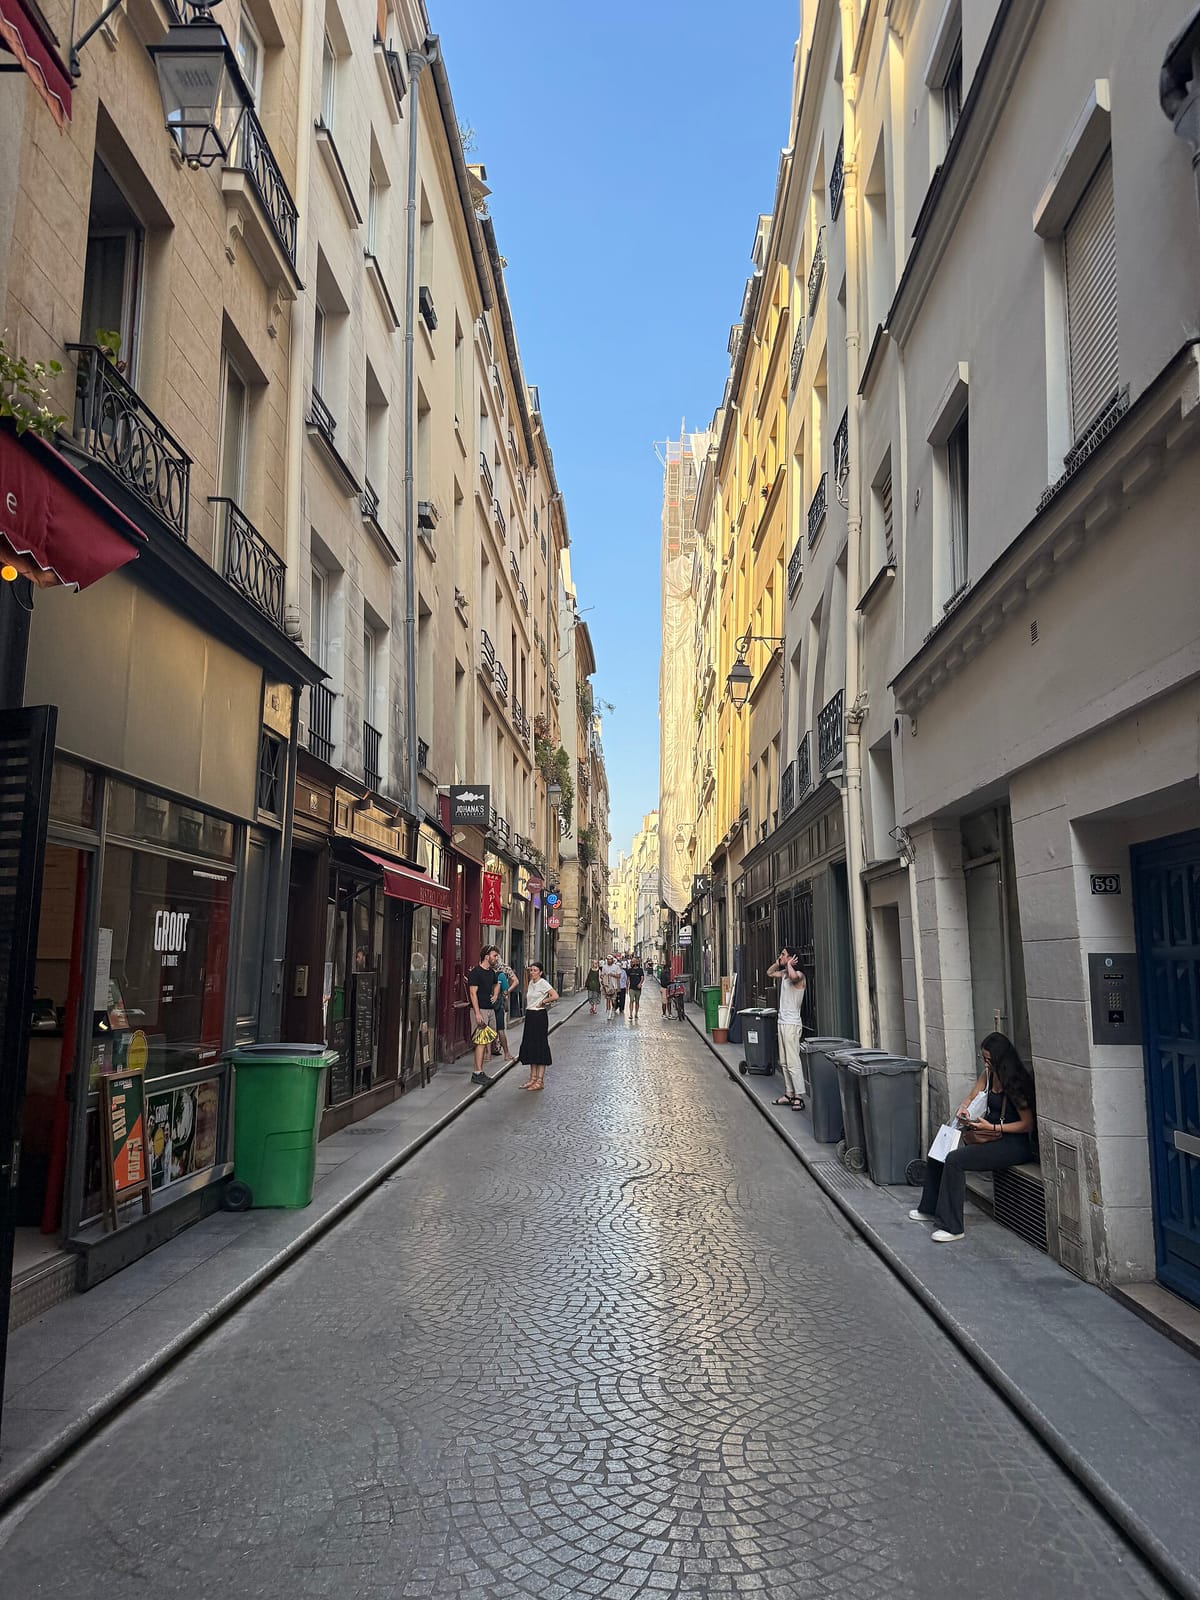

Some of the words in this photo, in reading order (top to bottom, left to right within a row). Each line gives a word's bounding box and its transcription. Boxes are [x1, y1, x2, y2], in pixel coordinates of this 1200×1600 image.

[696, 878, 704, 889] K
[1095, 878, 1117, 891] 59
[488, 879, 496, 917] TAPAS
[154, 910, 190, 952] GROOT
